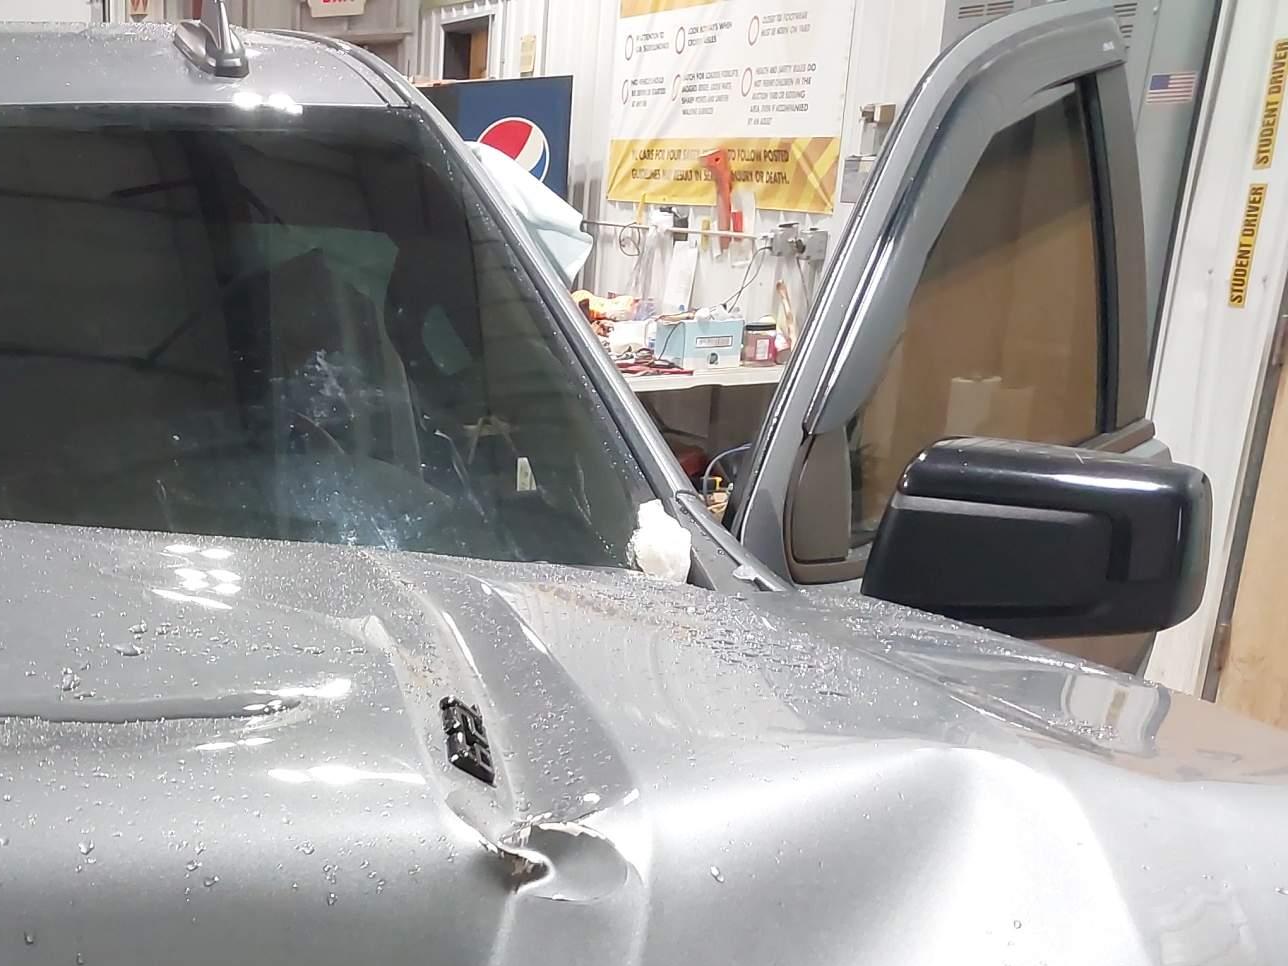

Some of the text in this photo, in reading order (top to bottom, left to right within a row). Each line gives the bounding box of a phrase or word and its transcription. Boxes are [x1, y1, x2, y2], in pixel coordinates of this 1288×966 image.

[763, 149, 789, 162] POSTED
[1255, 39, 1288, 165] STUDENT DRIVER
[1231, 185, 1265, 304] STUDENT DRIVER
